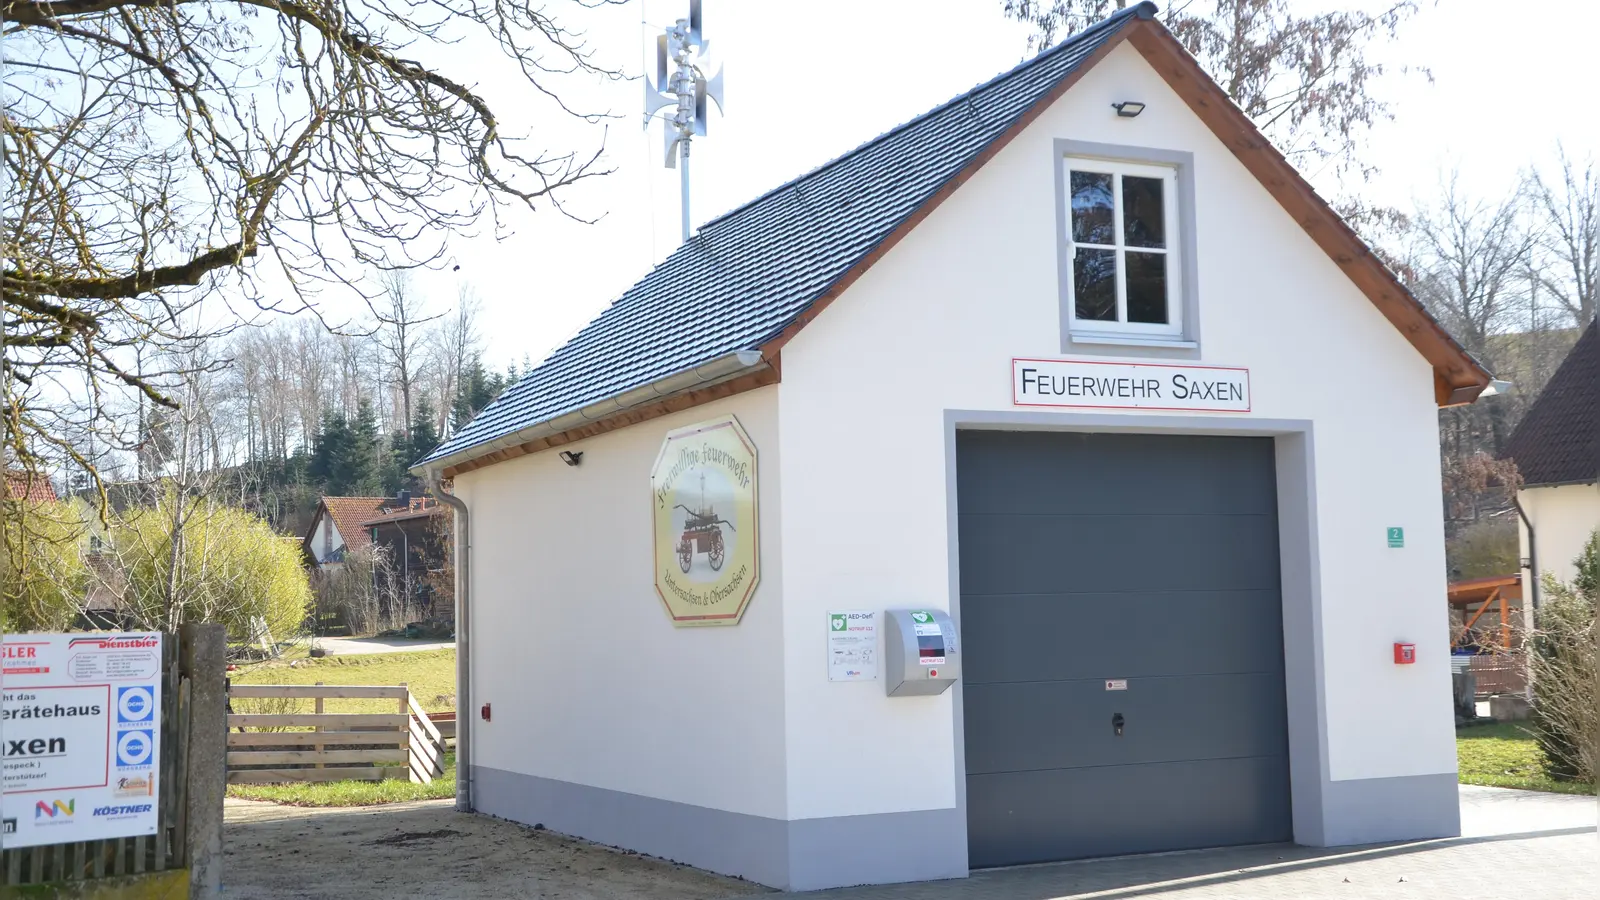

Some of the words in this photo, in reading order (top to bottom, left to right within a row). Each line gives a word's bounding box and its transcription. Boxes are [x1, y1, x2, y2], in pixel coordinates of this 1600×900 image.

[1022, 368, 1161, 398] FEUERWEHR
[1172, 374, 1243, 401] SAXEN
[1393, 528, 1399, 538] 2
[98, 636, 158, 649] Dienstbier
[17, 693, 36, 701] das
[3, 704, 101, 720] erätehaus
[3, 737, 66, 756] xen
[93, 804, 152, 816] KÖSTNER
